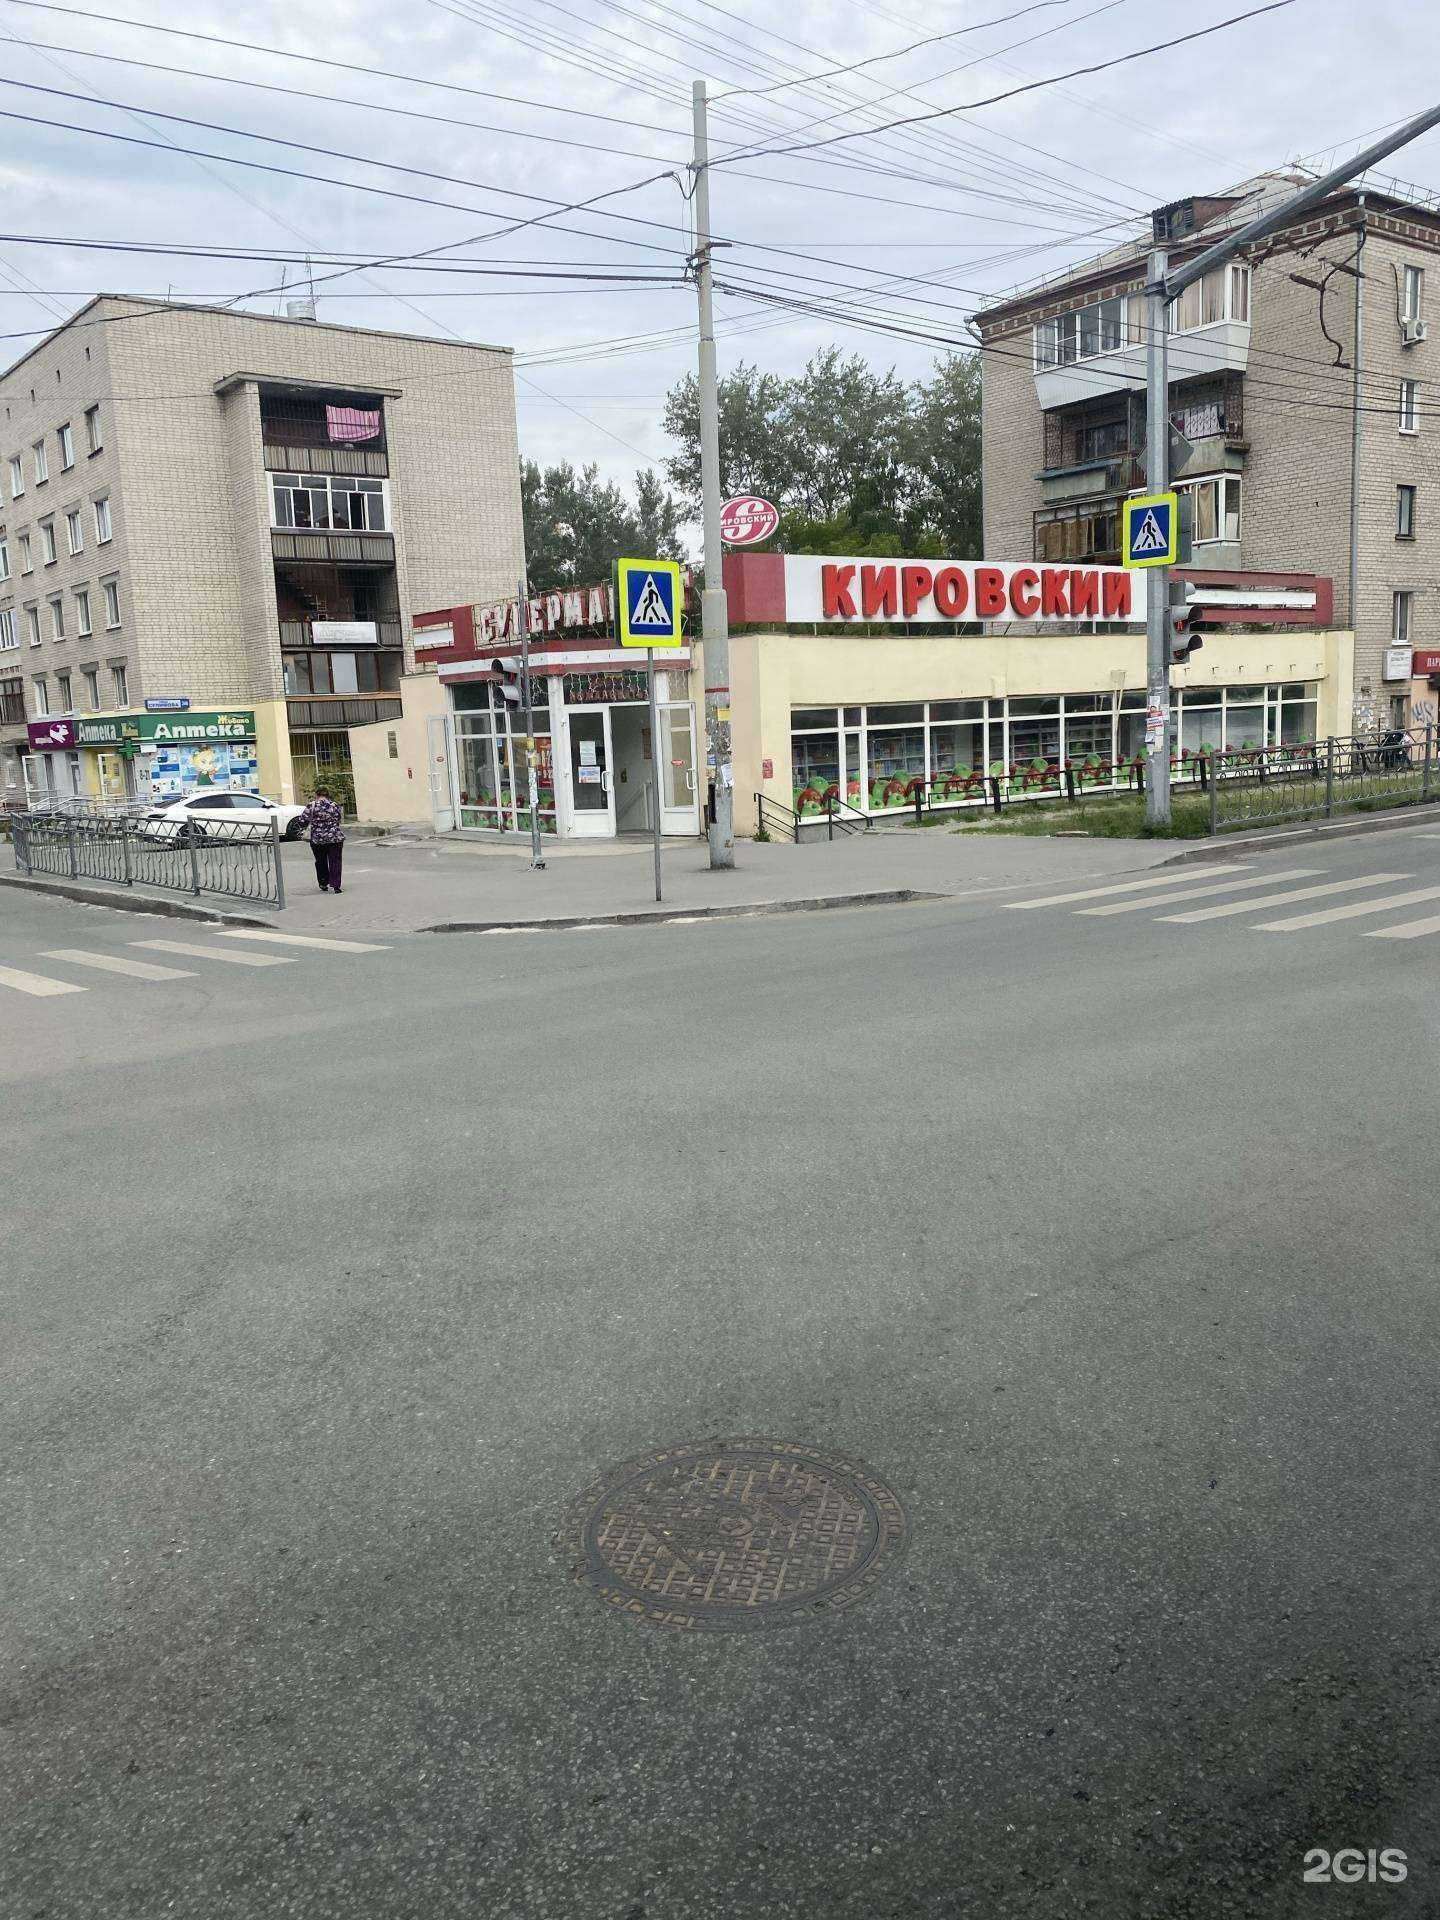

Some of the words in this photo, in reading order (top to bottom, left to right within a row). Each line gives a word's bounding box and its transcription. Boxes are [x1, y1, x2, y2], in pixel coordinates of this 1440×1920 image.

[720, 514, 774, 526] ИРОВСКИЙ
[478, 584, 617, 643] СУПЕРМА
[78, 722, 117, 741] Аптека
[153, 723, 246, 740] Аптека
